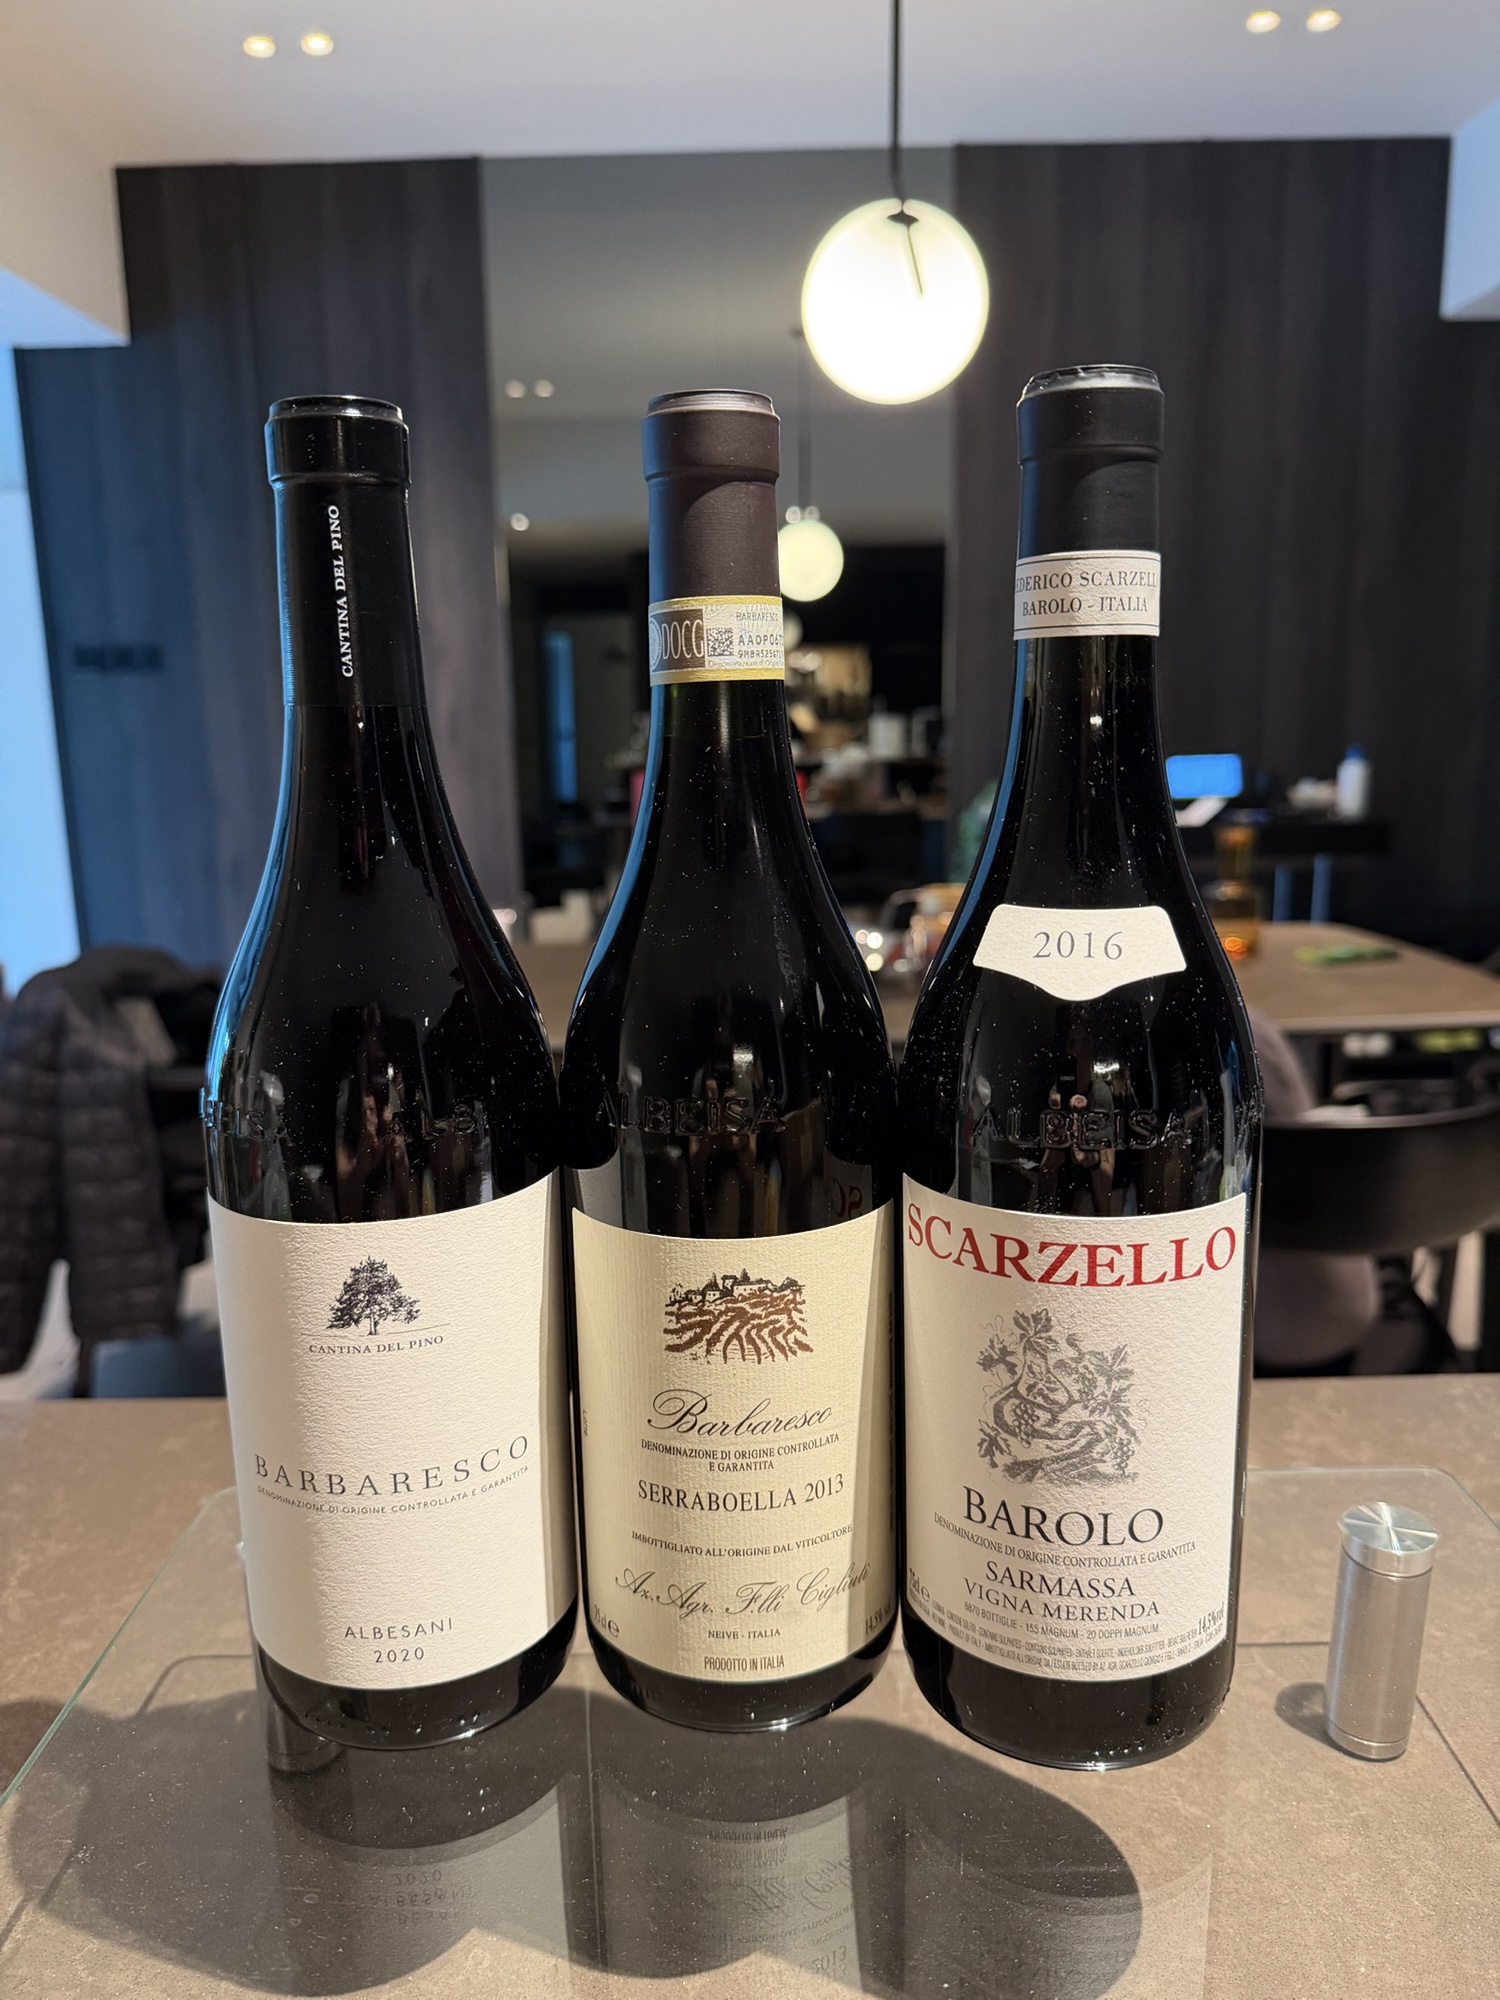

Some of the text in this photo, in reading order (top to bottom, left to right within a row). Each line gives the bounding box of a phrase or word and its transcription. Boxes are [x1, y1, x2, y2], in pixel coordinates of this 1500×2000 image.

[328, 505, 354, 678] CANTINA DEL PINO
[1015, 571, 1158, 593] EDERICO SCARZELL
[736, 612, 778, 622] BARBARESCO
[1022, 597, 1082, 616] BAROLO
[1100, 597, 1147, 612] ITALIA
[662, 619, 704, 660] DOCG
[1033, 930, 1123, 960] 2016
[598, 1089, 786, 1136] ALBEISA
[972, 1103, 1192, 1150] ALBEISA
[907, 1202, 1236, 1288] SCARZELLO
[309, 1335, 444, 1355] CANTINA DEL PINO
[647, 1388, 832, 1437] Barbaresco
[641, 1432, 840, 1460] DENOMINAZIONE DI ORIGINE CONTROLLATA
[254, 1436, 529, 1497] BARBARESCO
[709, 1460, 774, 1472] E GARANTITA
[257, 1465, 529, 1515] DENOMINAZIONE DI ORIGINE CONTROLLATA E GARANTITA
[638, 1473, 844, 1512] SERRABOELLA 2013
[963, 1485, 1164, 1546] BAROLO
[632, 1524, 853, 1558] IMBOTTIGLIATO ALL'ORIGINE DAL VITICOLTORE
[934, 1512, 1196, 1568] DENOMINAZIONE DI ORIGINE CONTROLLATA E GARANTITA
[986, 1560, 1136, 1599] SARMASSA
[963, 1578, 1033, 1615] VIGNA
[1042, 1600, 1160, 1622] MERENDA
[344, 1617, 453, 1640] ALBESANI
[708, 1630, 739, 1640] NEIVE
[748, 1628, 781, 1640] ITALIA
[981, 1607, 1017, 1629] BOTTIGLIE
[1025, 1622, 1039, 1634] 155
[1041, 1625, 1079, 1639] MAGNUM
[1086, 1629, 1097, 1639] 20
[1098, 1627, 1123, 1639] DOPPI
[1124, 1623, 1159, 1638] MAGNUM
[374, 1647, 425, 1663] 2020
[704, 1654, 785, 1672] PRODOTTO IN ITALIA
